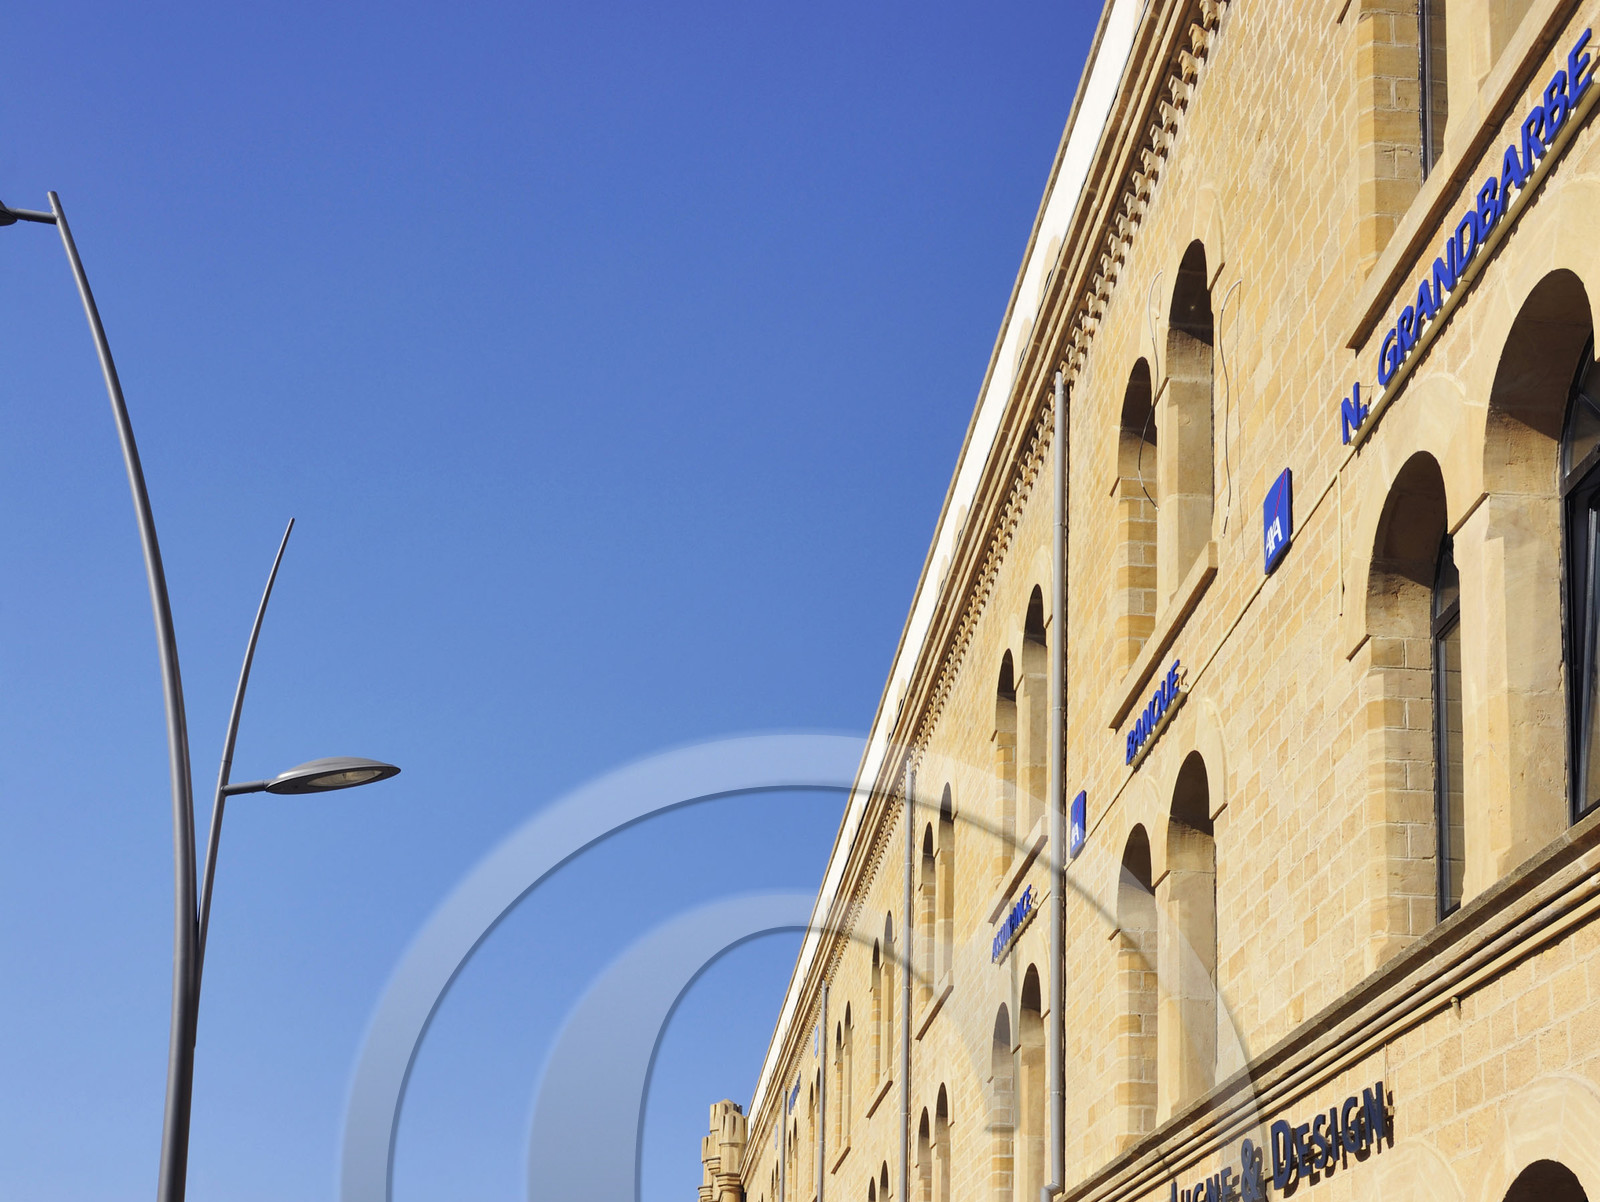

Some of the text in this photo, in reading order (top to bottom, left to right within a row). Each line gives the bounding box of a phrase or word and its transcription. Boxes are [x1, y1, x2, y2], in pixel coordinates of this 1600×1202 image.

[1341, 27, 1593, 445] N. GRANDBARBE
[1126, 659, 1180, 766] BANQUE
[1270, 1081, 1385, 1191] DESIGN
